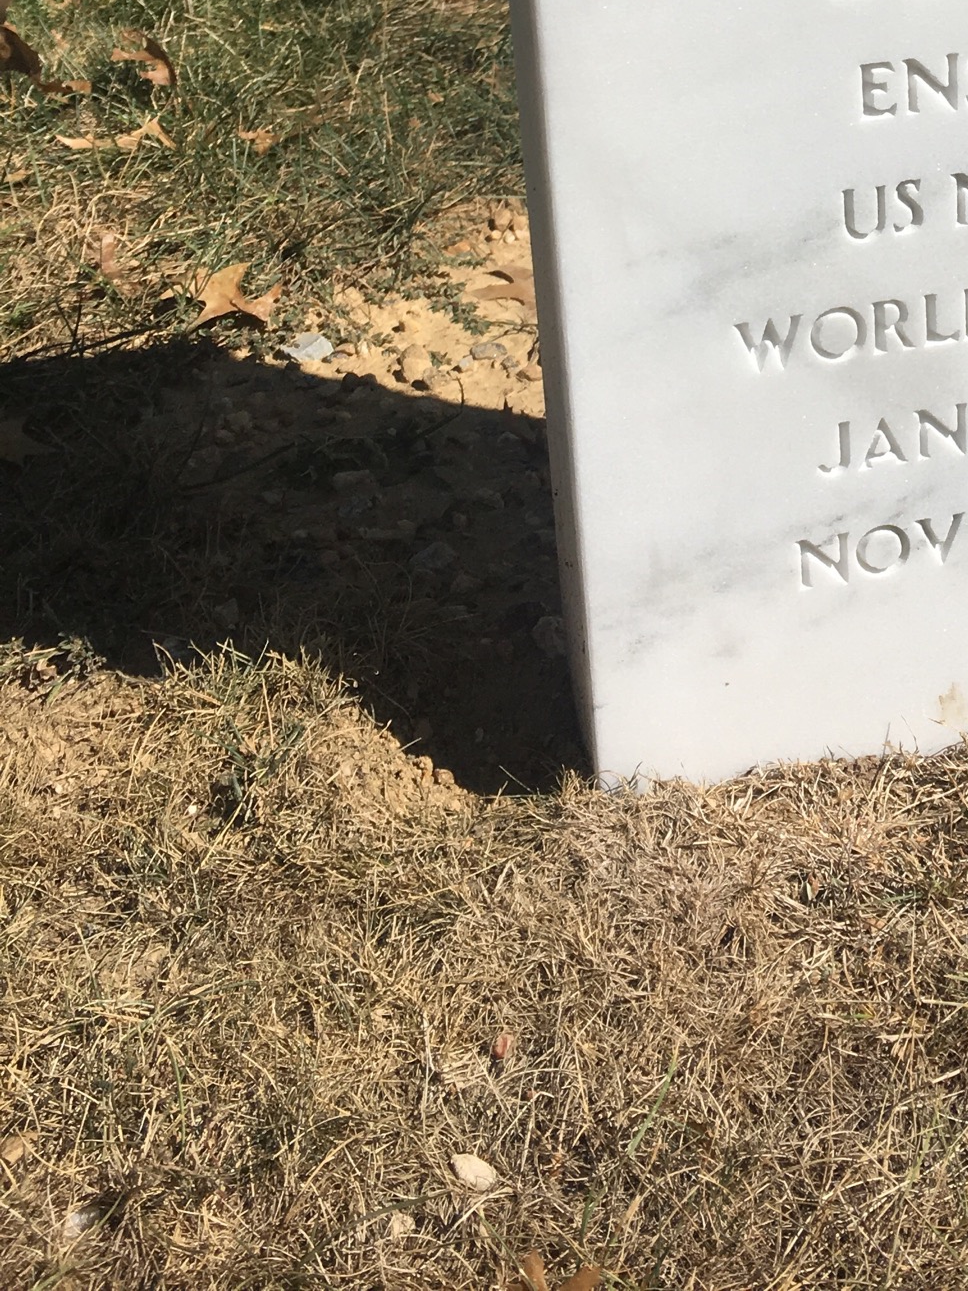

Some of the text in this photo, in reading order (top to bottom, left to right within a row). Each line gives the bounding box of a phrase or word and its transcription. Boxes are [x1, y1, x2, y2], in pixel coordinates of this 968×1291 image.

[841, 178, 924, 240] US
[817, 402, 968, 475] JAN
[795, 511, 965, 589] NOV
